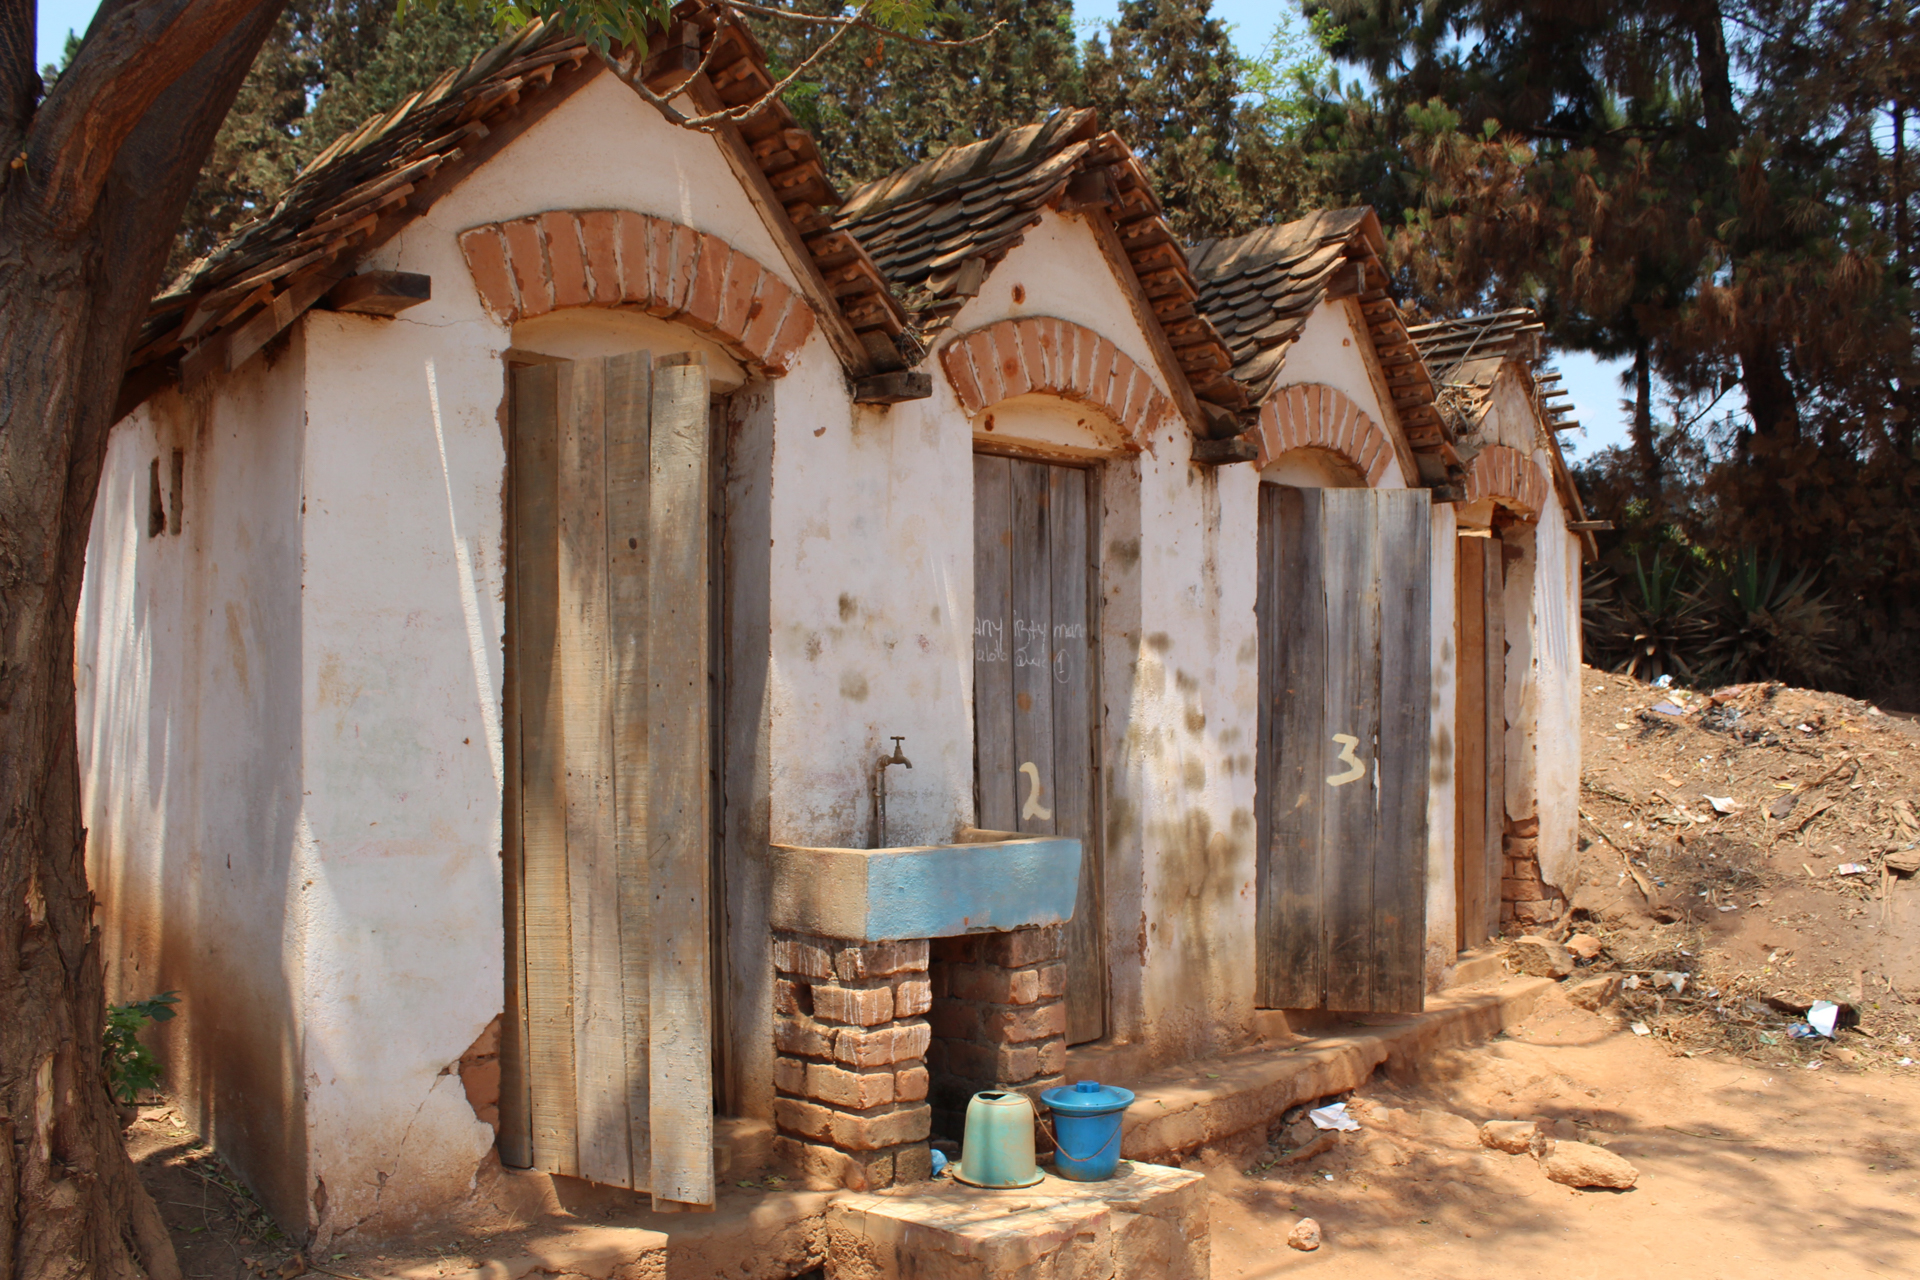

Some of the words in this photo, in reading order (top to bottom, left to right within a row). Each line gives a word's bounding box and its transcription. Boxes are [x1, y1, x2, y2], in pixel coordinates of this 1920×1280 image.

[974, 617, 1003, 653] any
[1326, 733, 1366, 787] 3
[1019, 761, 1051, 820] 2
